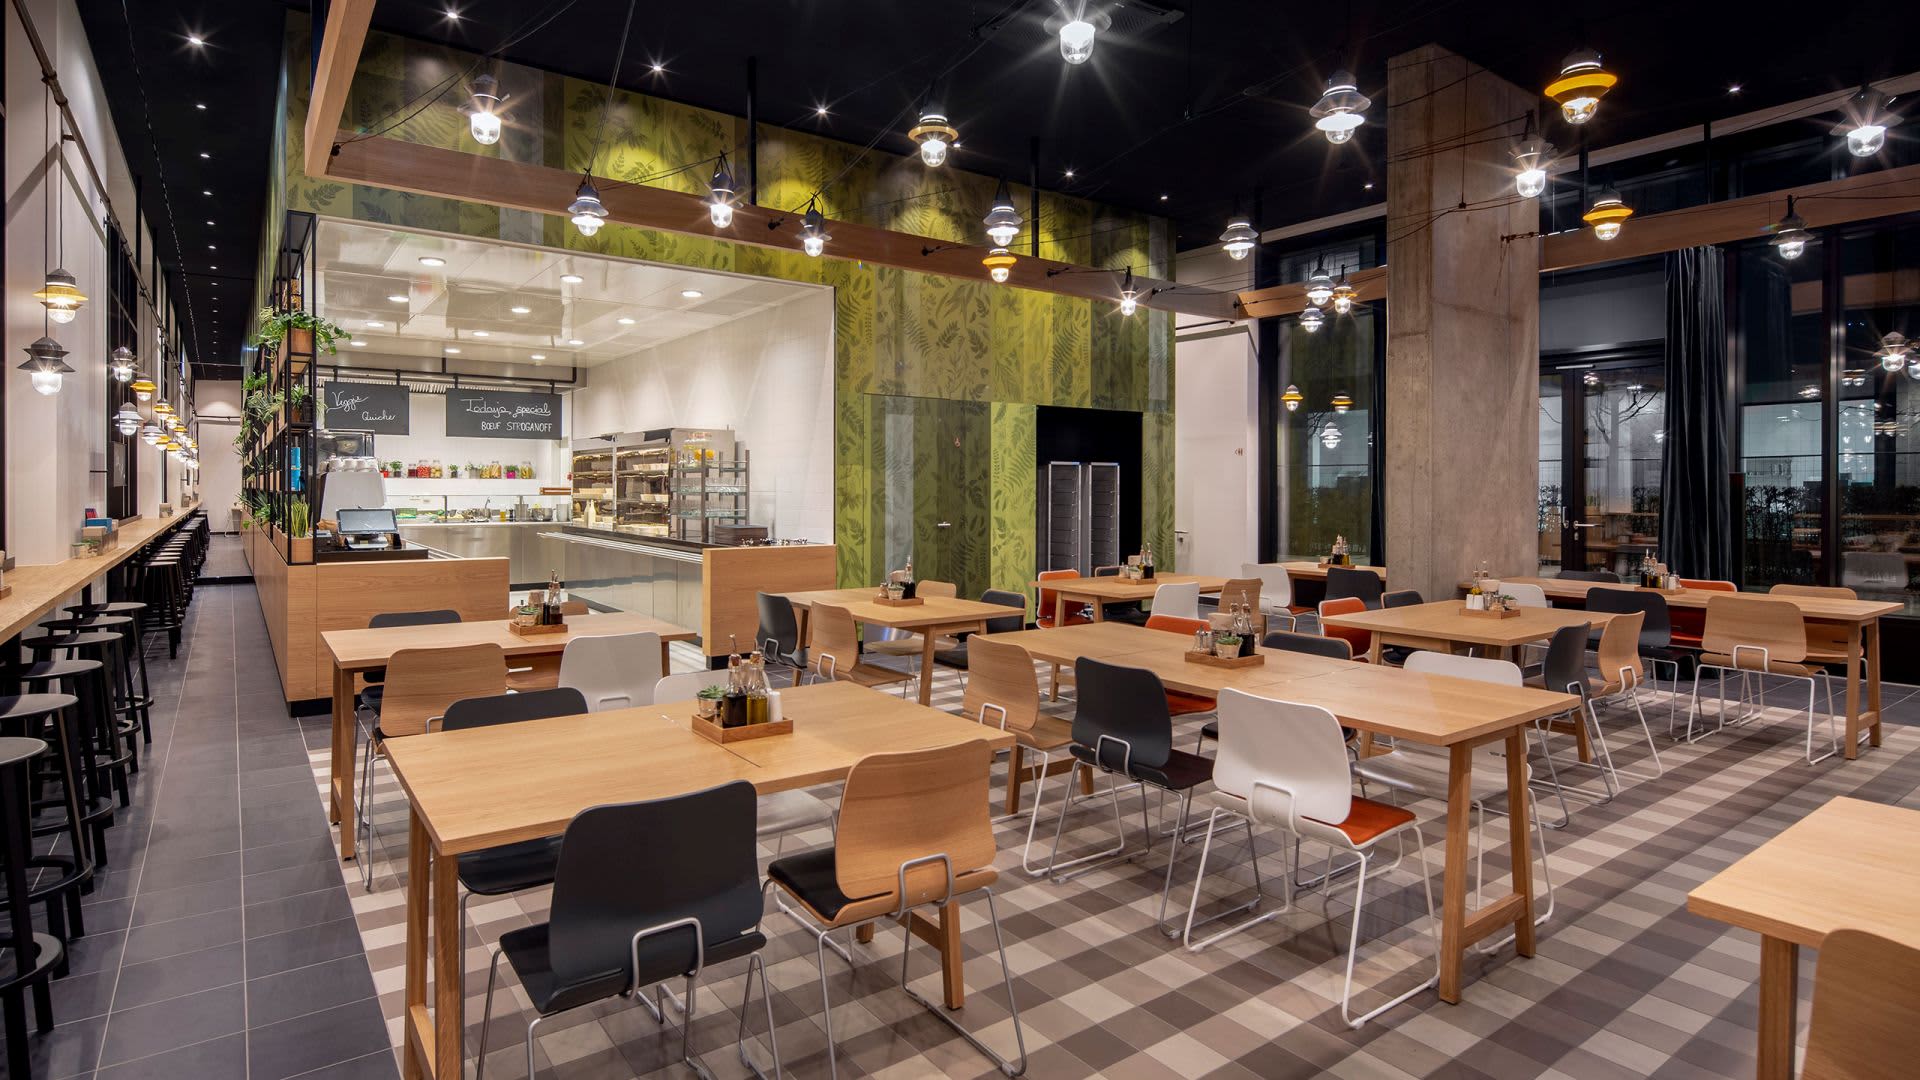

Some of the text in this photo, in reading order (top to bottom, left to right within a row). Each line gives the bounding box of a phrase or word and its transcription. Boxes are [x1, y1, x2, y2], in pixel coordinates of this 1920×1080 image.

[326, 390, 369, 413] Veggie
[361, 409, 396, 421] Quiche
[512, 402, 552, 418] special
[506, 421, 553, 432] STROGANOFF
